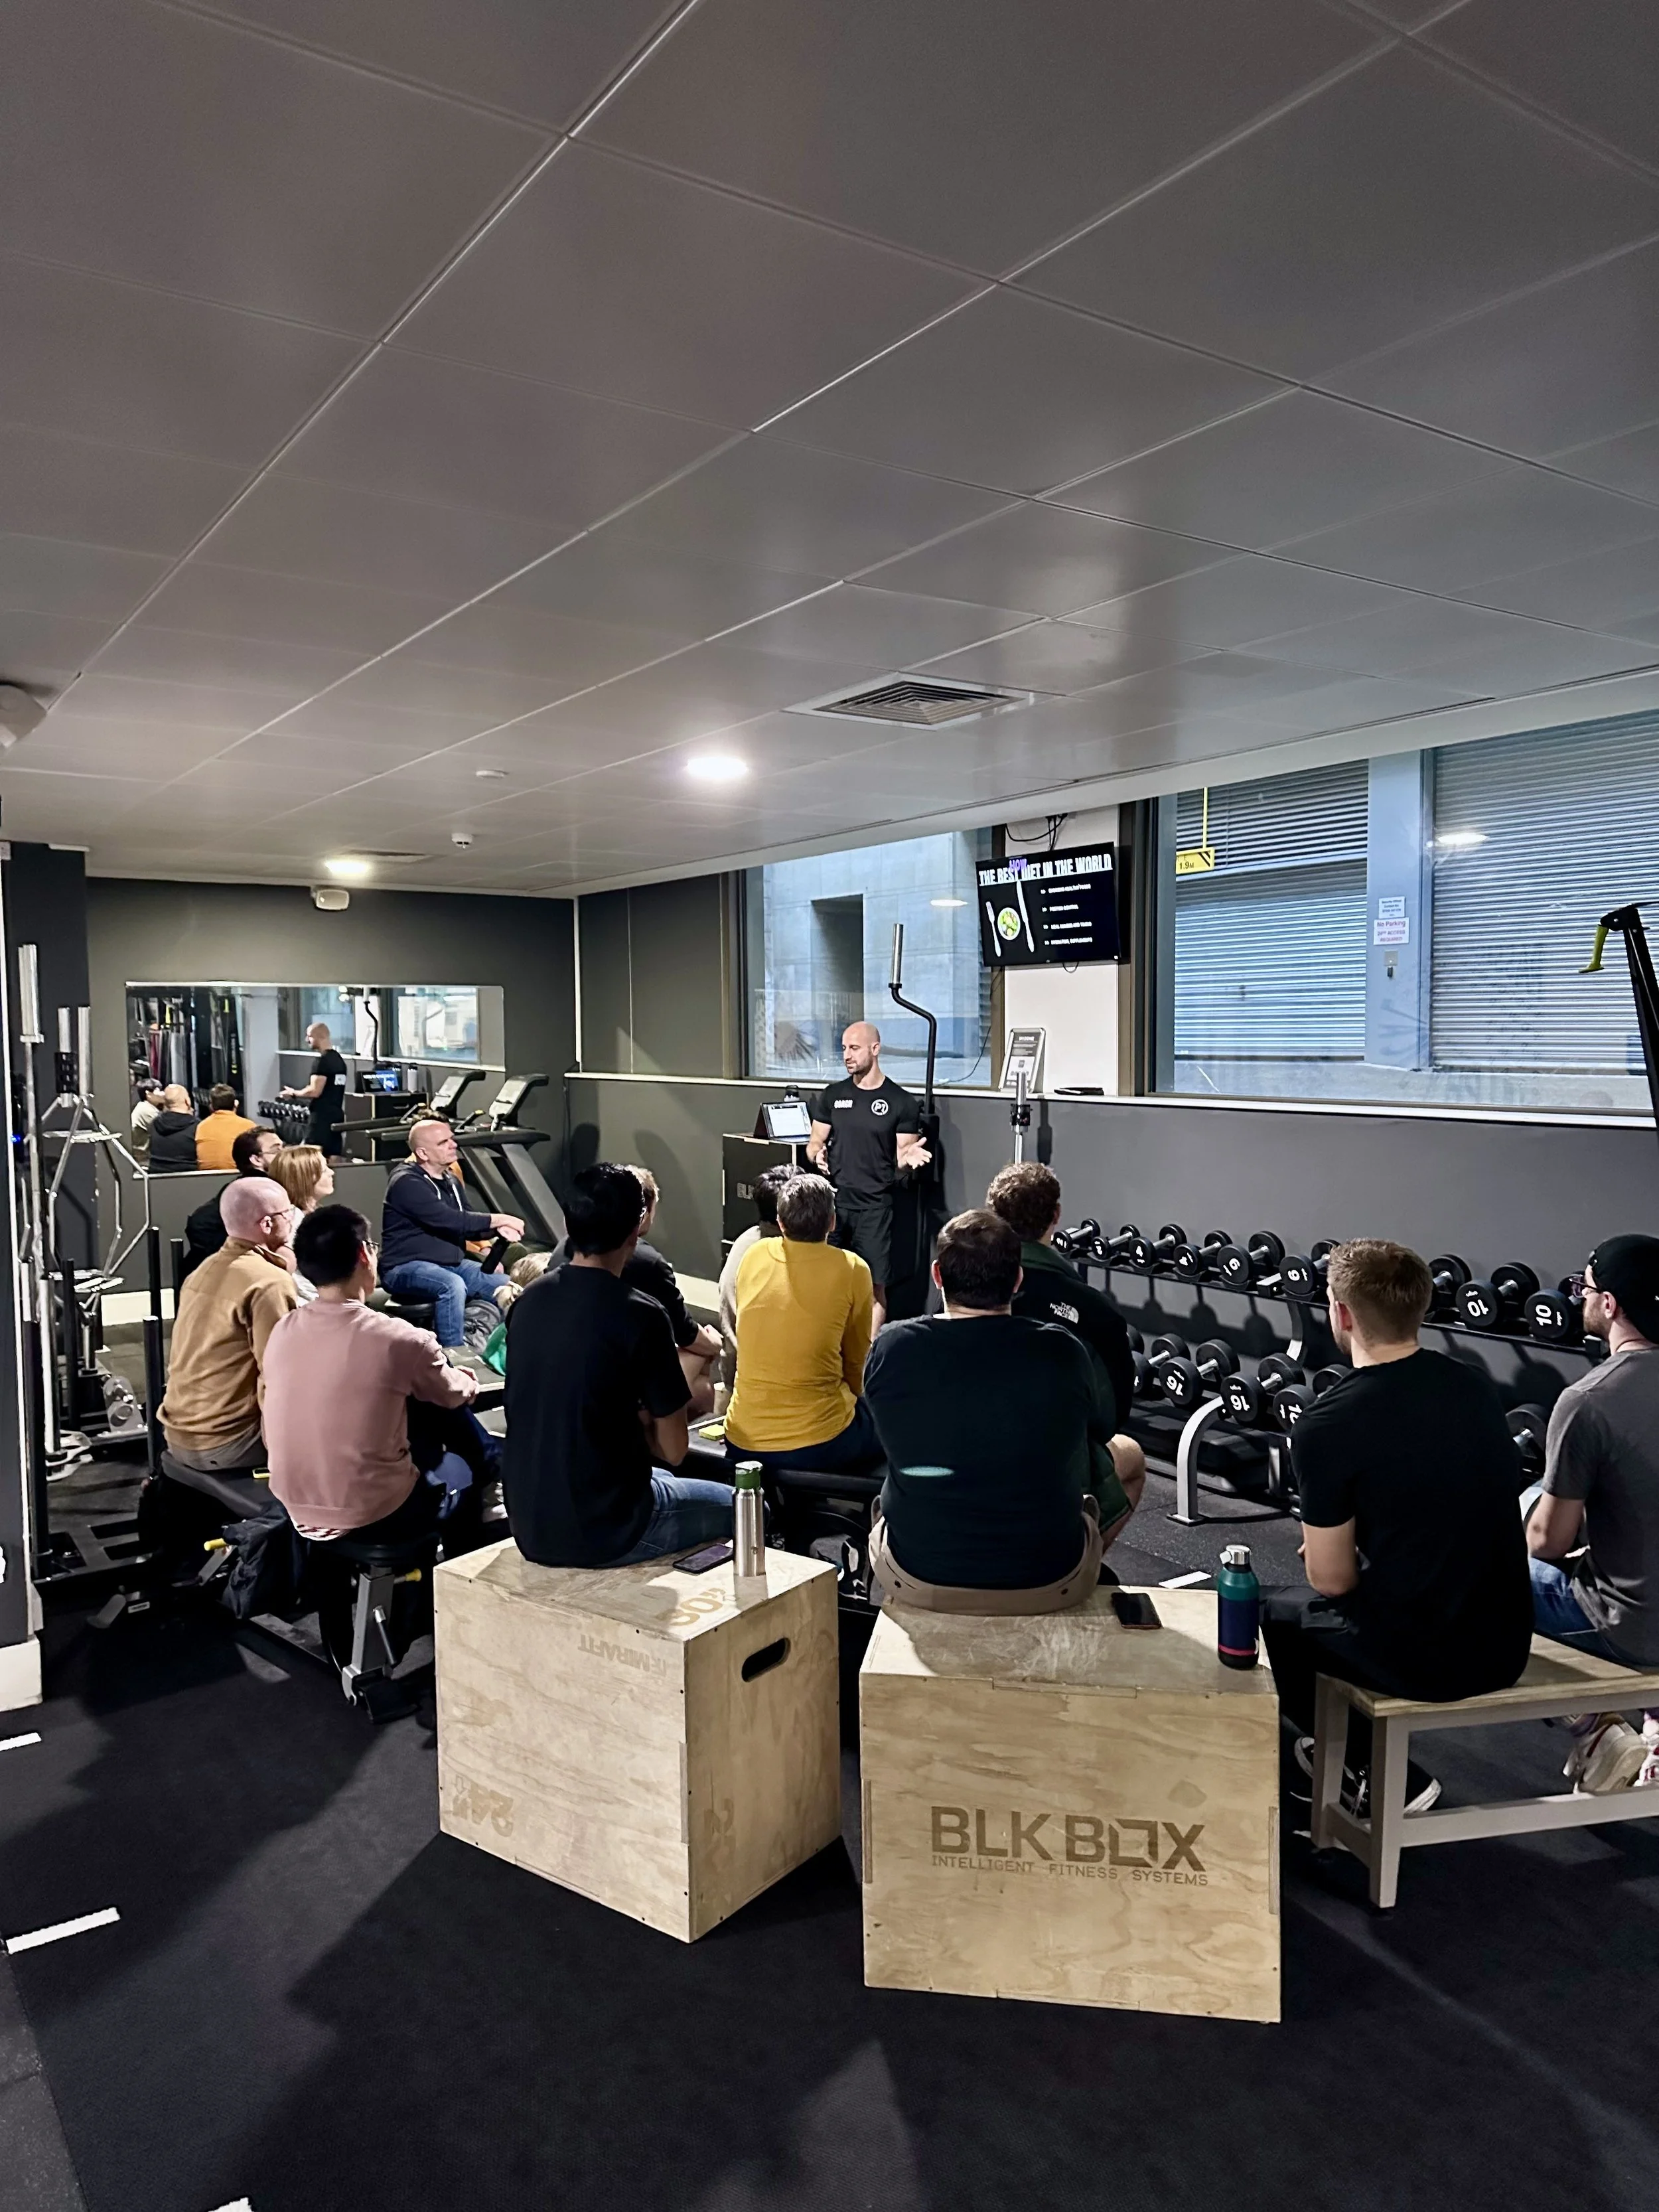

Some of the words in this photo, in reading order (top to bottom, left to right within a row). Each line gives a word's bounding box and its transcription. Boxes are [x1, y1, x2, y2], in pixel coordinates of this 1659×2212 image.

[979, 869, 995, 886] THE
[1043, 861, 1053, 879] IN
[1055, 859, 1074, 877] THE
[1075, 854, 1113, 875] WORLD
[1467, 1299, 1489, 1317] 10
[1535, 1304, 1552, 1327] 10
[1166, 1375, 1184, 1396] 16
[1230, 1394, 1250, 1412] 16
[577, 1634, 650, 1672] MIRAFIT
[932, 1855, 1035, 1874] INTELLIGENT
[1049, 1864, 1119, 1880] FITNESS
[1132, 1869, 1208, 1886] SYSTEMS
